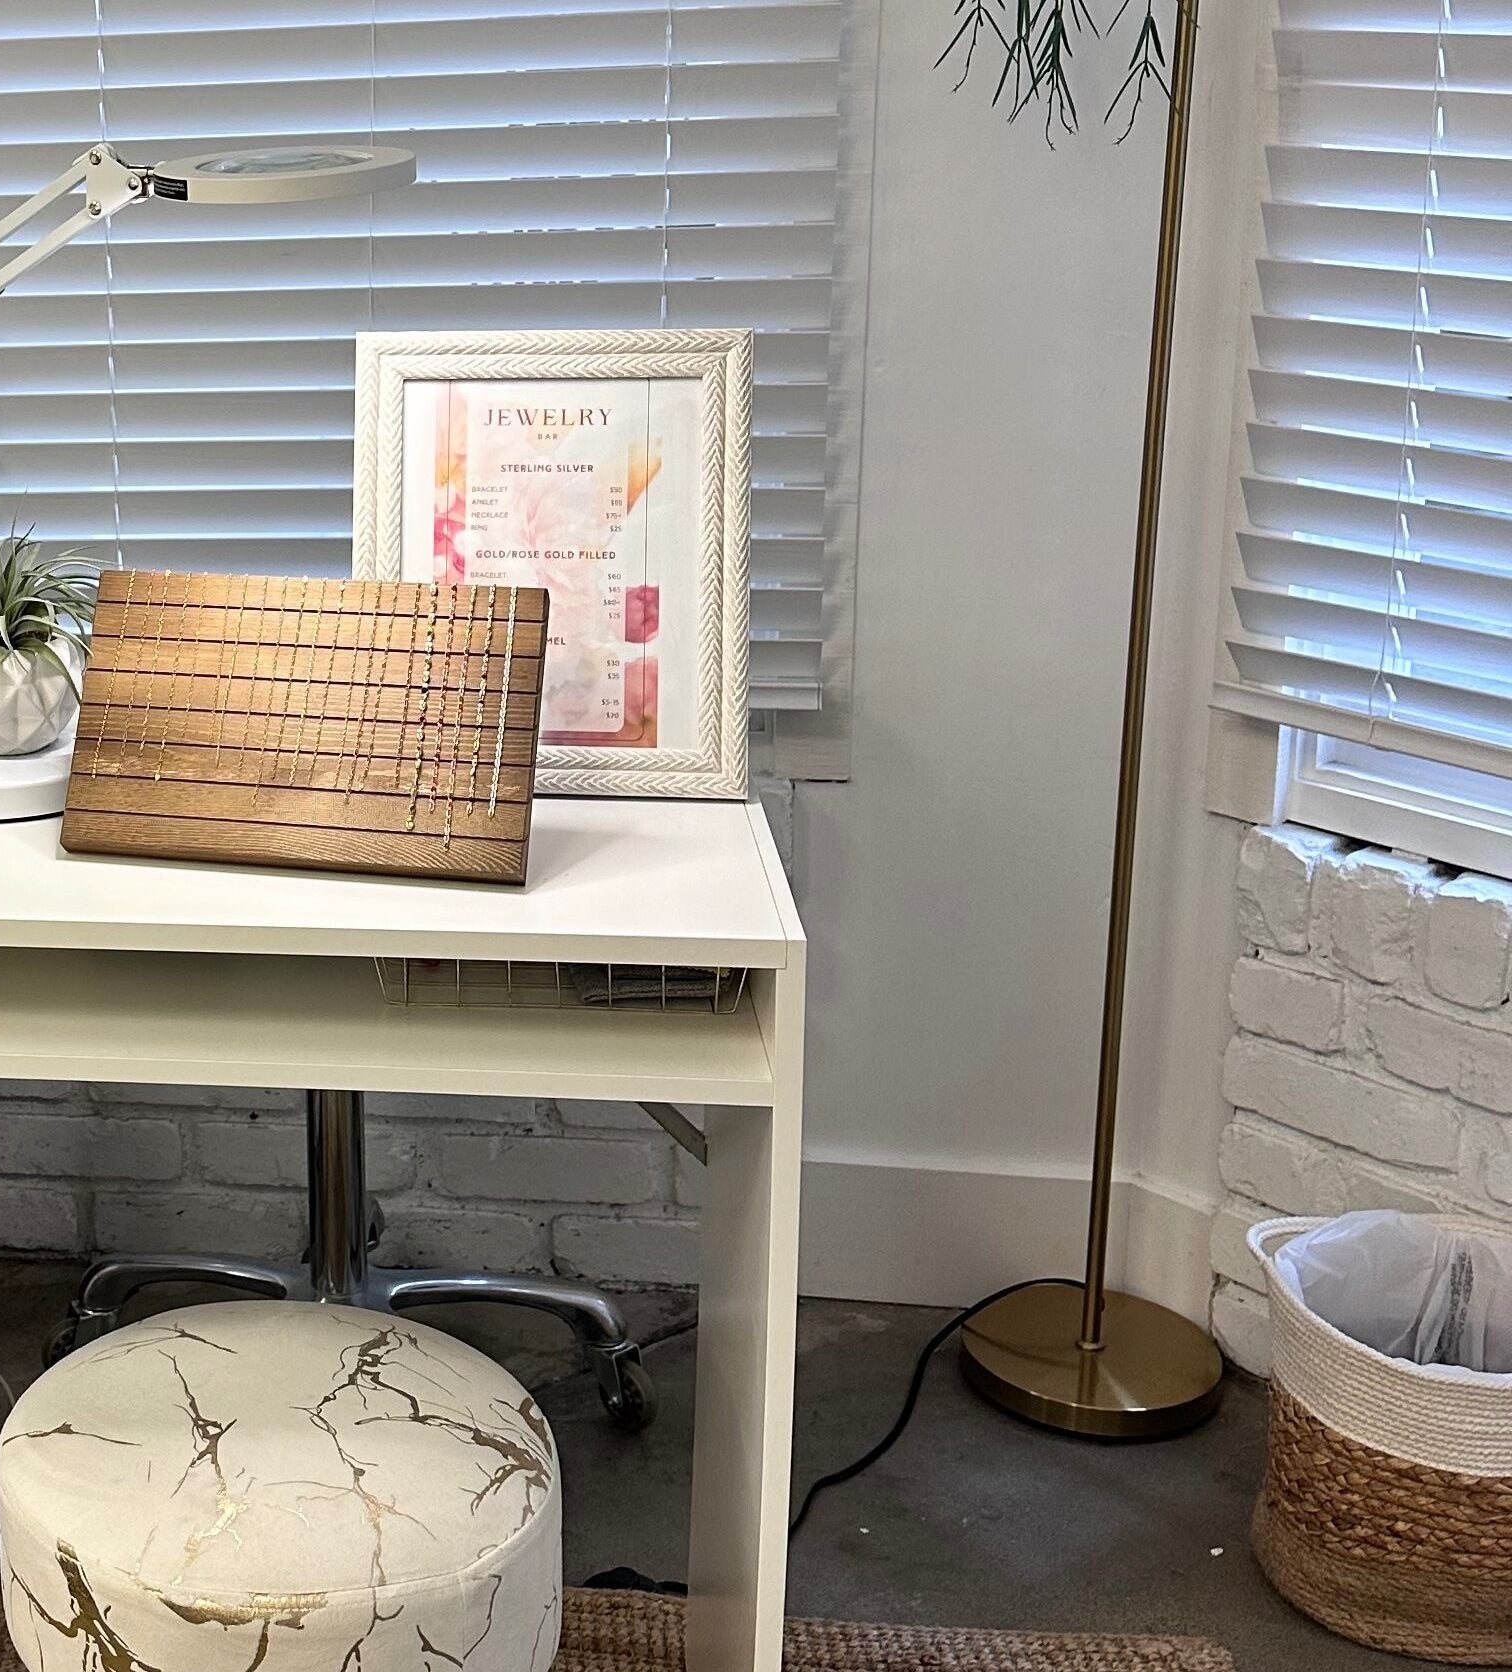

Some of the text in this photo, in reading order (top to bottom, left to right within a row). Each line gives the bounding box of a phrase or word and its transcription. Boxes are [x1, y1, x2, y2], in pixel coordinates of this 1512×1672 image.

[483, 408, 613, 426] JEWELRY
[500, 464, 594, 473] STERLING SILVER
[475, 550, 617, 560] GOLD/ROSE GOLD FILLED
[470, 571, 507, 579] BRACELET
[547, 637, 566, 646] MEL
